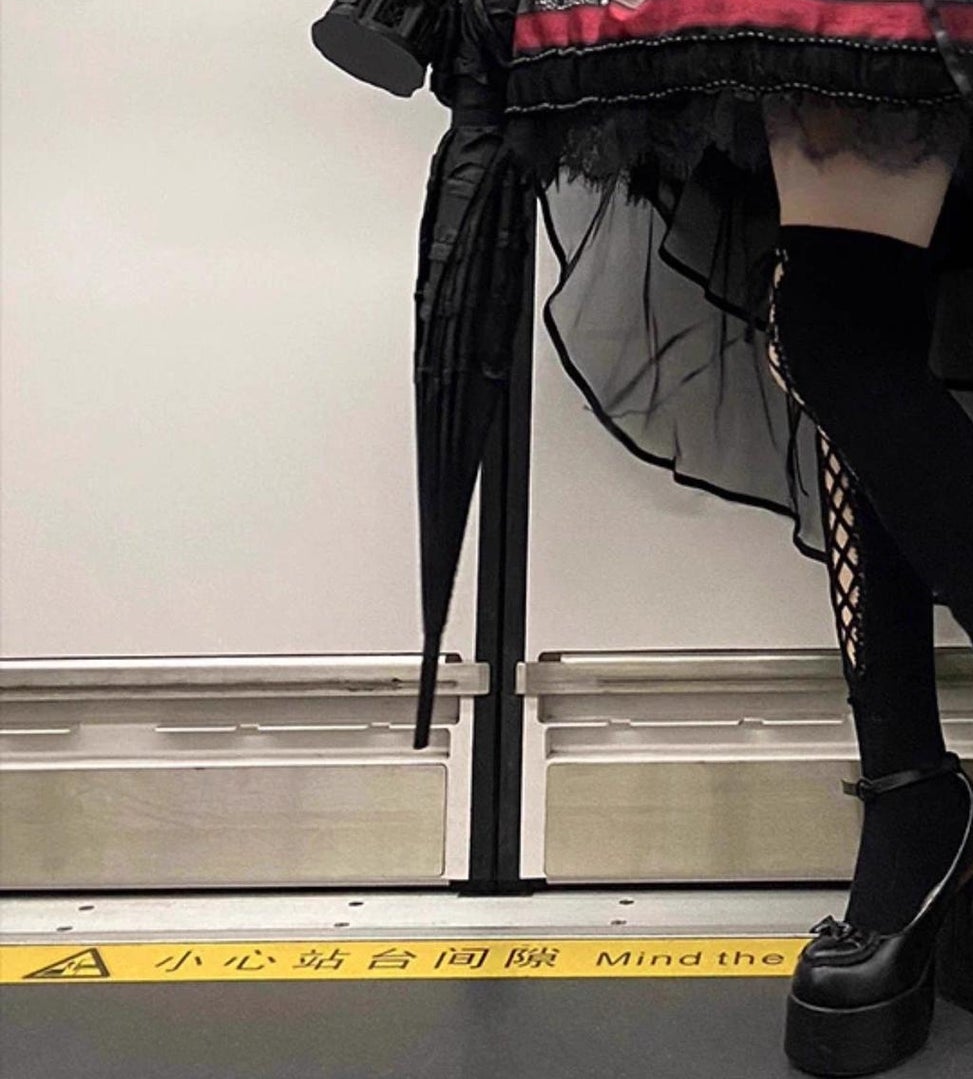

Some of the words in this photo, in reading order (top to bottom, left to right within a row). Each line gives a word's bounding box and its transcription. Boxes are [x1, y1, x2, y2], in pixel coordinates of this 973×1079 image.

[154, 946, 560, 973] 小心站台间隙
[595, 950, 702, 968] Mind
[717, 949, 785, 967] the
